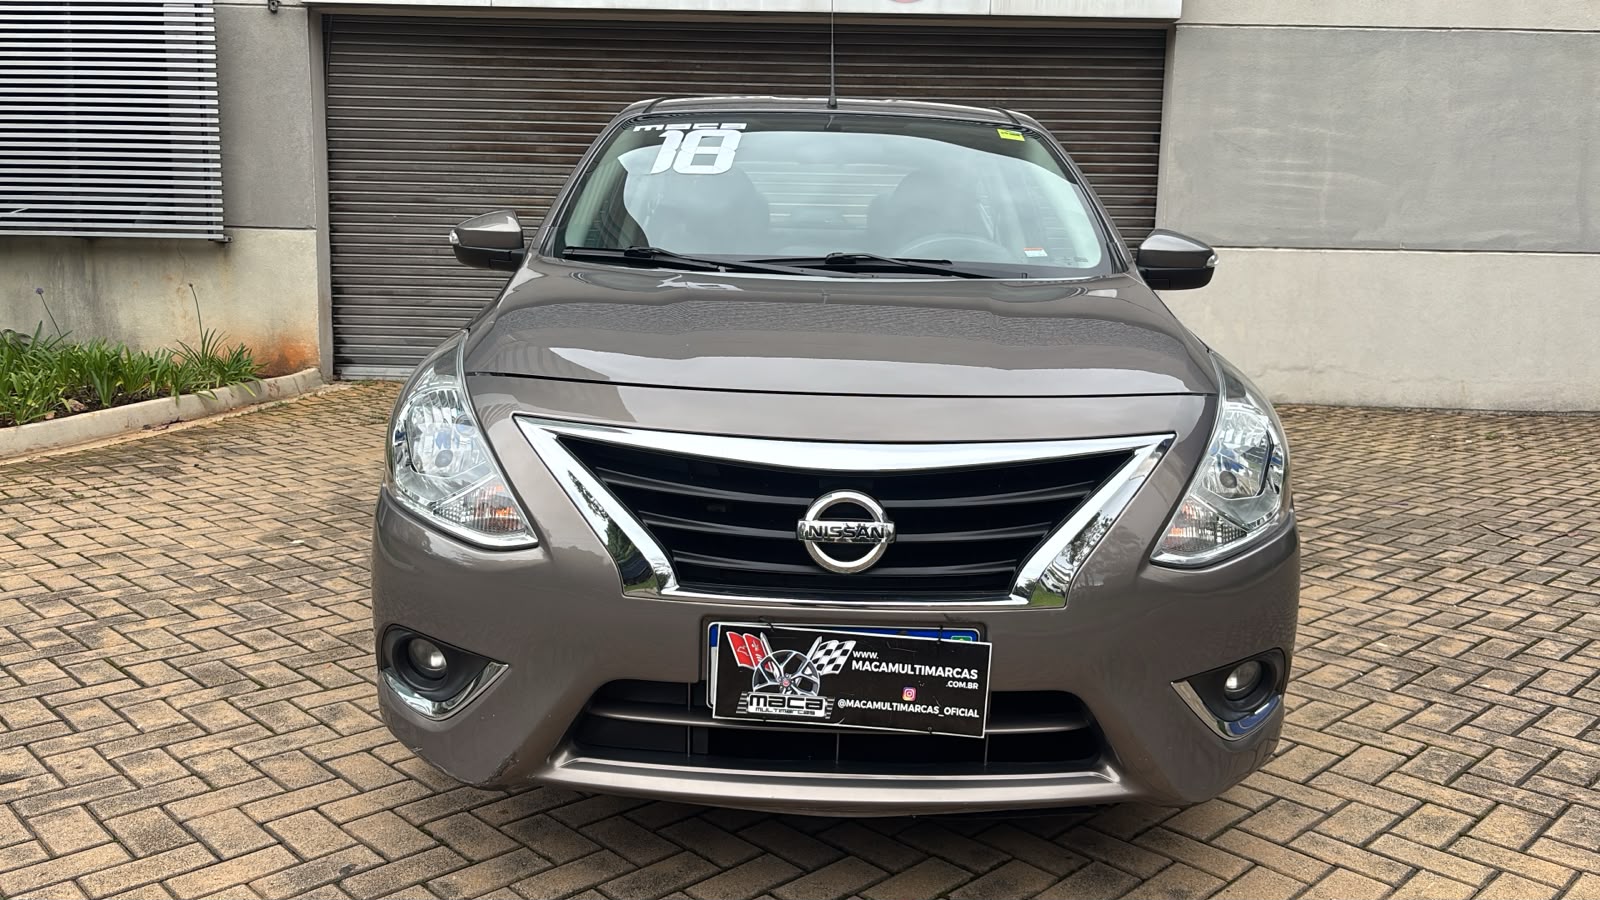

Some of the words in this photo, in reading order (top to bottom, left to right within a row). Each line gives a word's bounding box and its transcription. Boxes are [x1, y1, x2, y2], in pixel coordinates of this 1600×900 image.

[650, 130, 742, 175] 18
[807, 525, 886, 540] NISSAN
[851, 660, 979, 680] MACAMULTIMARCAS
[945, 680, 979, 690] .COM.BR
[837, 698, 980, 719] @MACAMULTIMARCAS_OFICIAL
